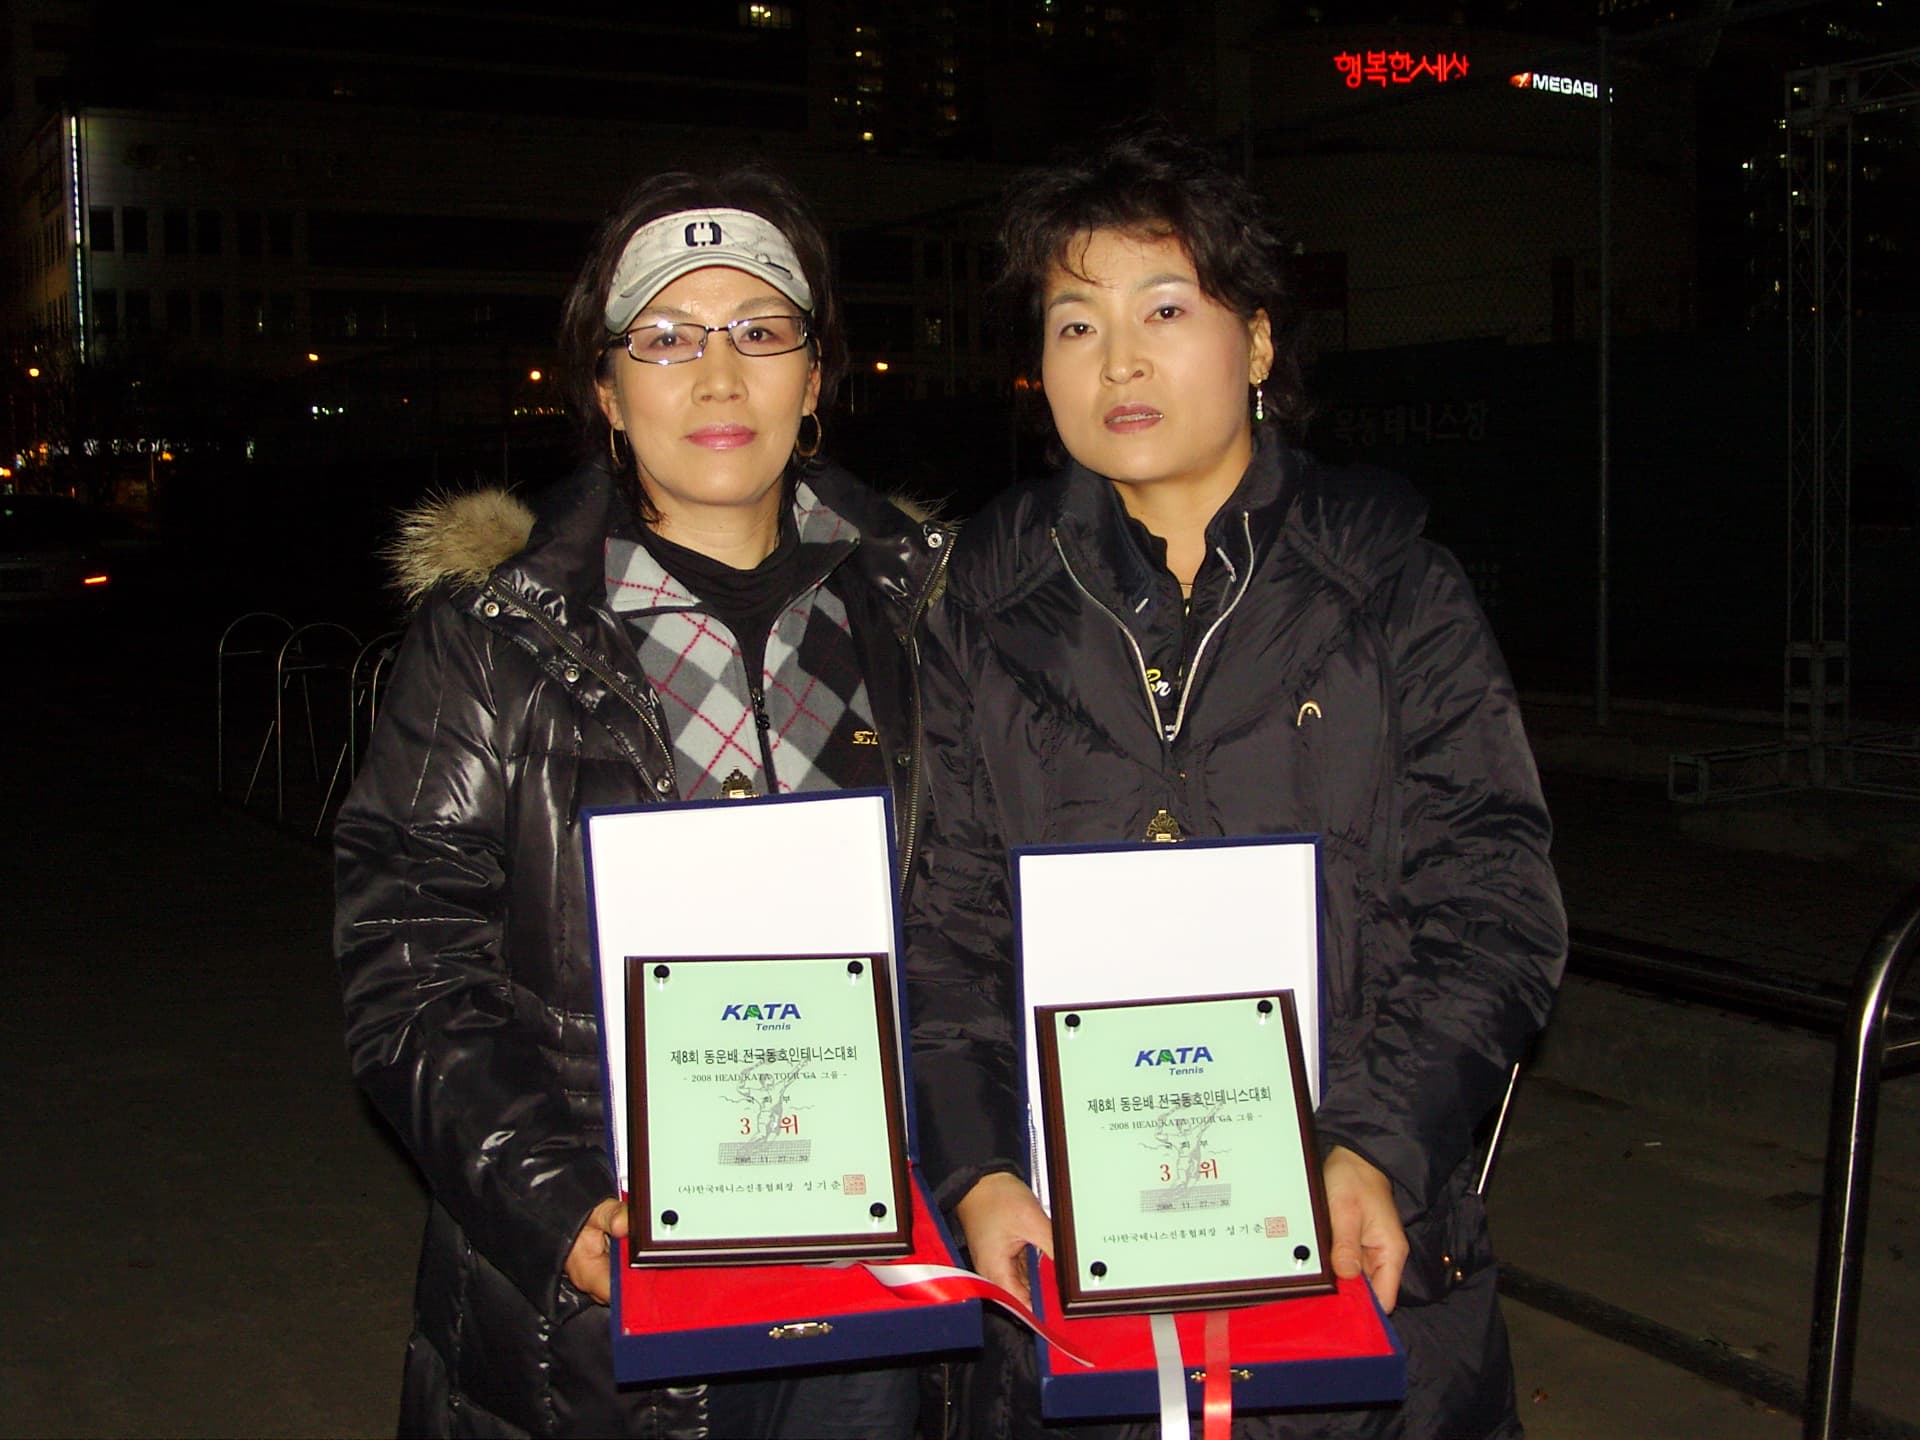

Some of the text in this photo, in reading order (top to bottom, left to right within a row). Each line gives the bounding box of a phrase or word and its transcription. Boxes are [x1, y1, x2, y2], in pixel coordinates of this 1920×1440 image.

[1332, 49, 1470, 90] 행복한세상
[720, 1003, 802, 1021] KATA
[755, 1022, 792, 1032] Tennis
[670, 1045, 858, 1065] 제8회 동운배 전국동호인테니스대회
[1134, 1046, 1214, 1068] KATA
[691, 1073, 712, 1083] 2008
[714, 1073, 741, 1083] HEAD
[1168, 1066, 1205, 1077] Tennis
[1087, 1086, 1272, 1114] 제8회 동운배 전국동호인테니스대회
[739, 1114, 799, 1135] 3 위
[1109, 1121, 1130, 1131] 2008
[1132, 1119, 1158, 1130] HEAD
[1159, 1158, 1218, 1182] 3 위
